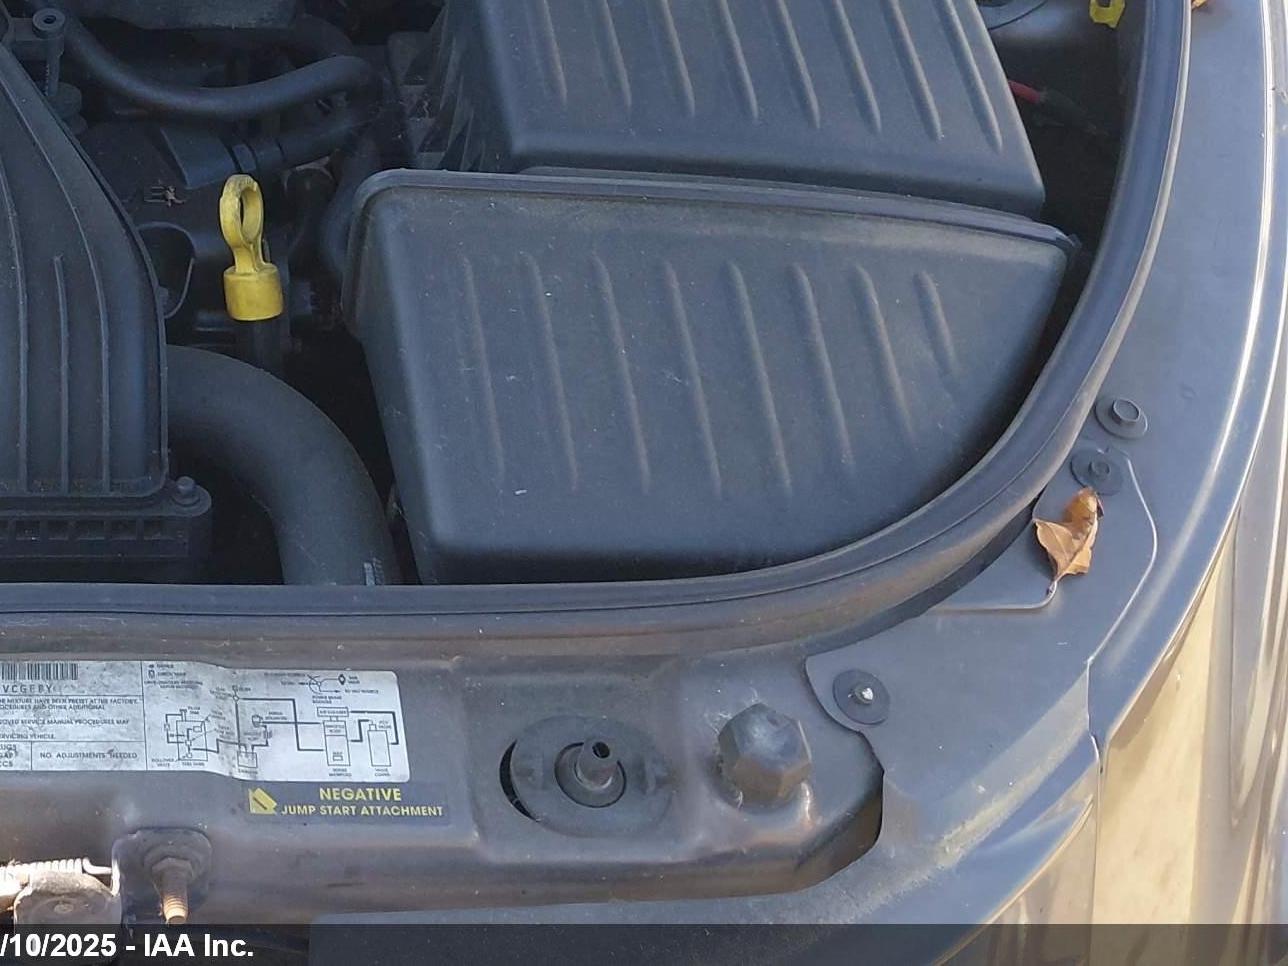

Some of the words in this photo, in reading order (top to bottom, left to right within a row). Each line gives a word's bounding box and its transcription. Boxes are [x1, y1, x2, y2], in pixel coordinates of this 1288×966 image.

[319, 788, 402, 801] NEGATIVE
[281, 805, 316, 816] JUMP
[319, 805, 357, 816] START
[361, 806, 443, 817] ATTACHMENT
